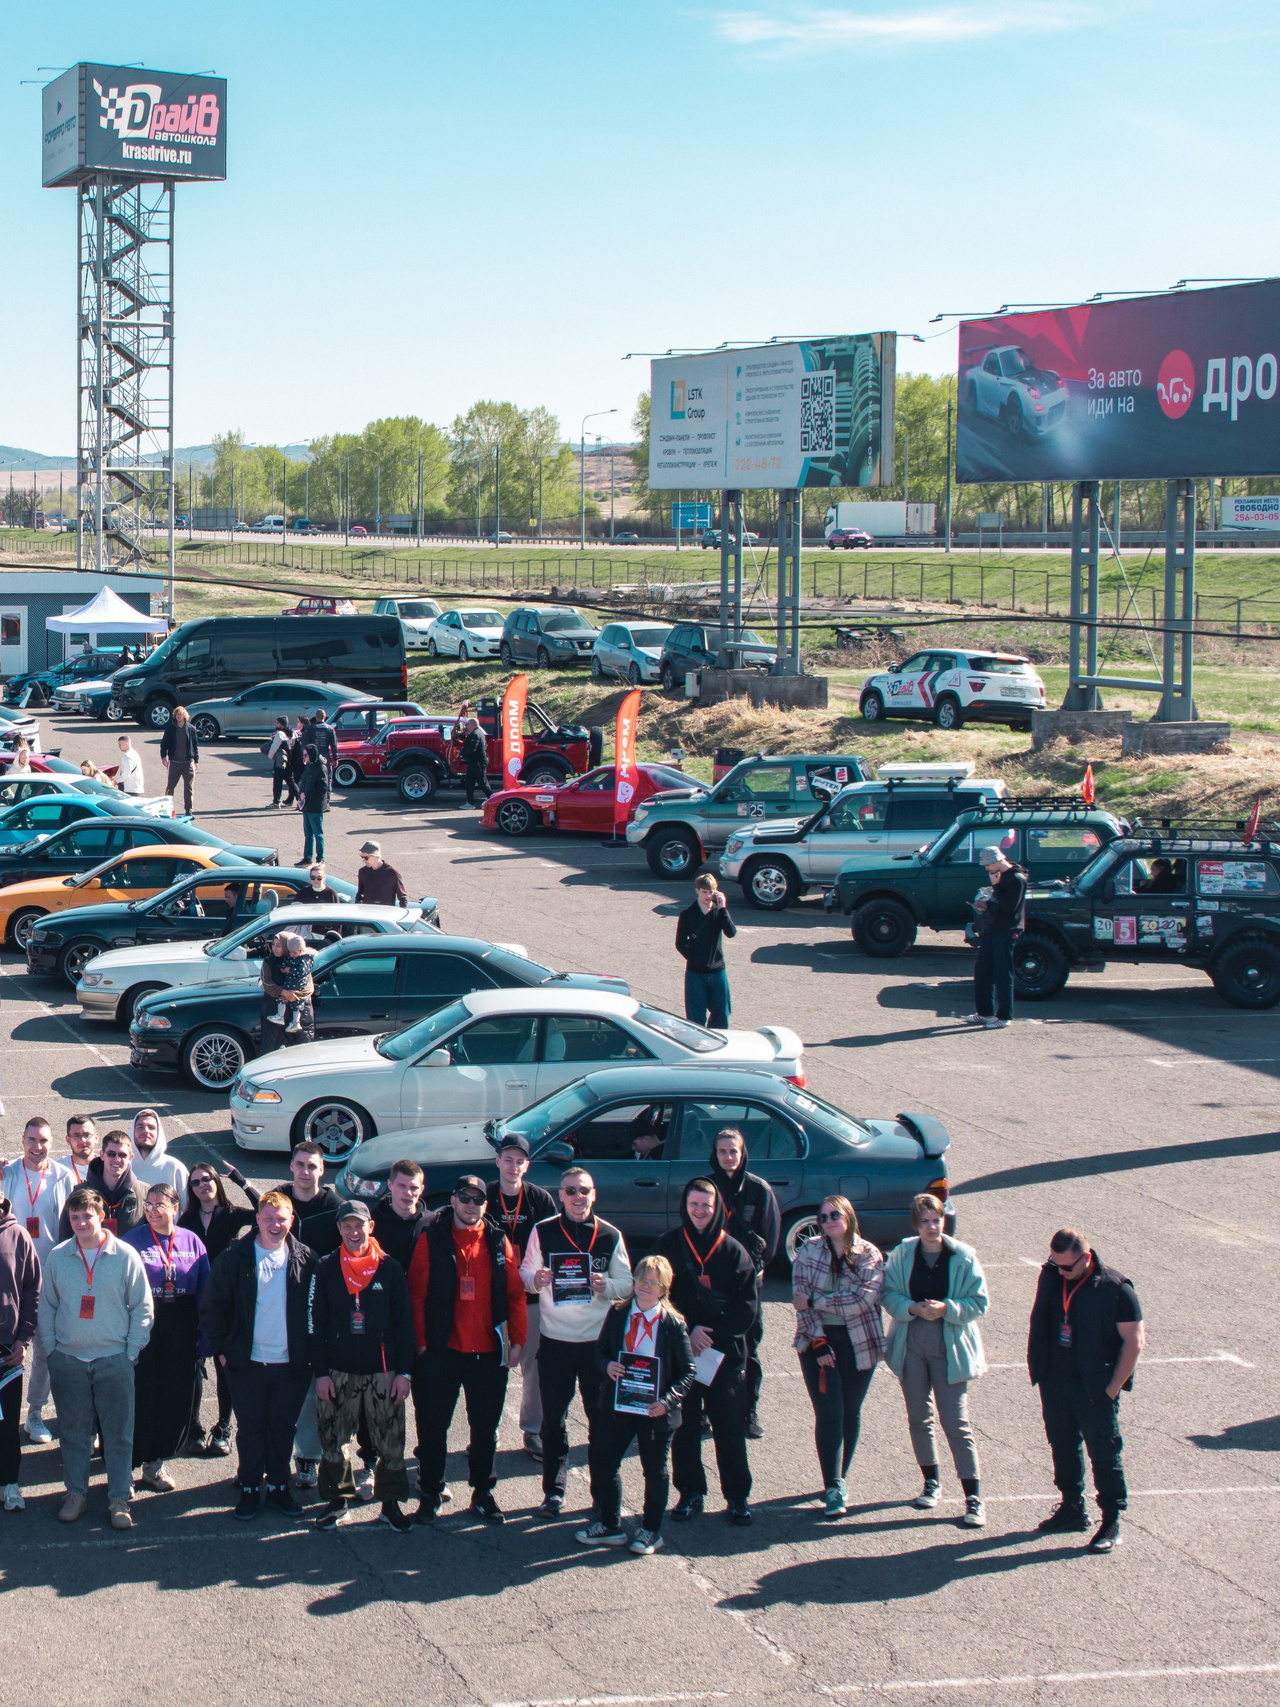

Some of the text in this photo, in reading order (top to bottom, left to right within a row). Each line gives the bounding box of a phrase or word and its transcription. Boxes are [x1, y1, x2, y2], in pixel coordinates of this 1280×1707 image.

[155, 131, 217, 146] автошкола
[122, 142, 192, 164] krasdrive.ru
[1087, 367, 1141, 390] За авто
[687, 388, 703, 400] LSTK
[1087, 395, 1135, 419] иди на
[687, 408, 705, 420] Group
[734, 457, 781, 471] 222-48-72
[1234, 504, 1279, 512] СВОБОДНО
[1234, 513, 1279, 521] 256-03-05
[750, 804, 764, 817] 25
[1096, 919, 1112, 930] 20
[1119, 922, 1132, 940] 5
[562, 1258, 581, 1266] JST
[308, 1273, 316, 1306] POWER
[631, 1360, 650, 1369] JST
